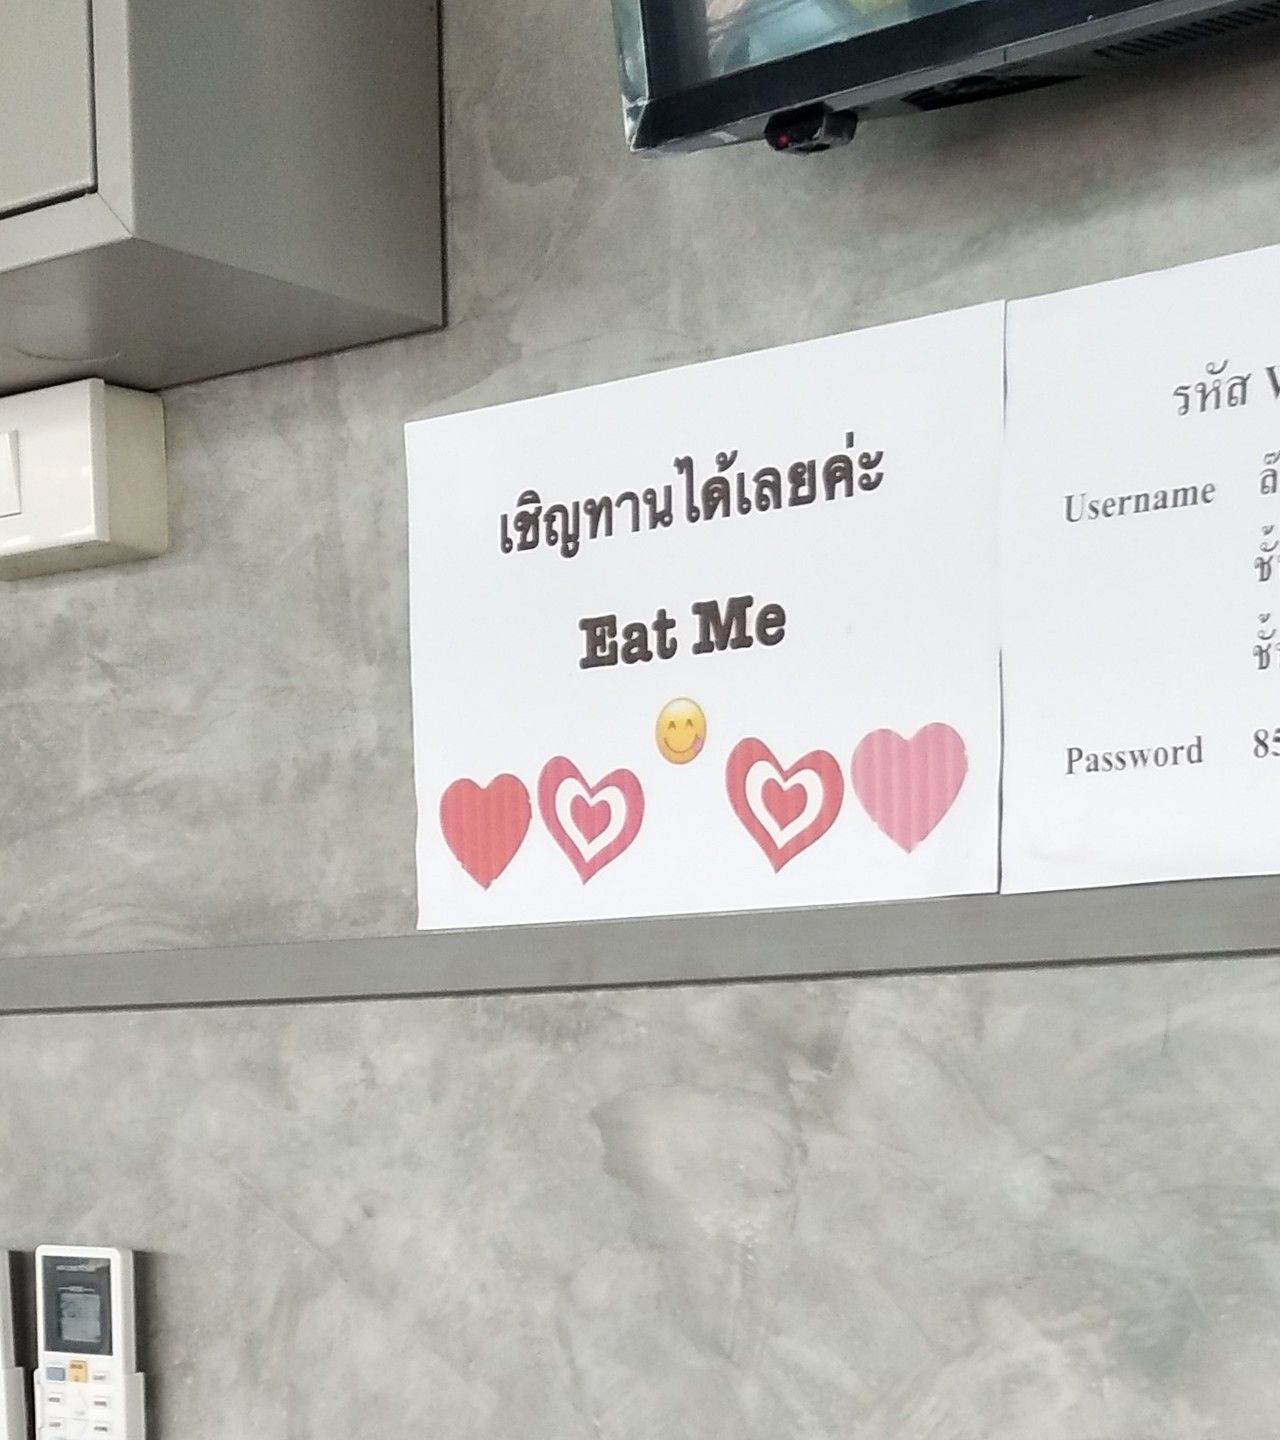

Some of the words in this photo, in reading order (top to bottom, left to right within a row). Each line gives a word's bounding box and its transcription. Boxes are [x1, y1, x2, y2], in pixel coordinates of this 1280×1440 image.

[1172, 359, 1253, 417] รหัส
[499, 430, 886, 559] เชิญทานได้เลยค่ะ
[1064, 482, 1217, 523] Username
[578, 607, 679, 671] Eat
[690, 594, 787, 656] Me
[1065, 735, 1204, 775] Password
